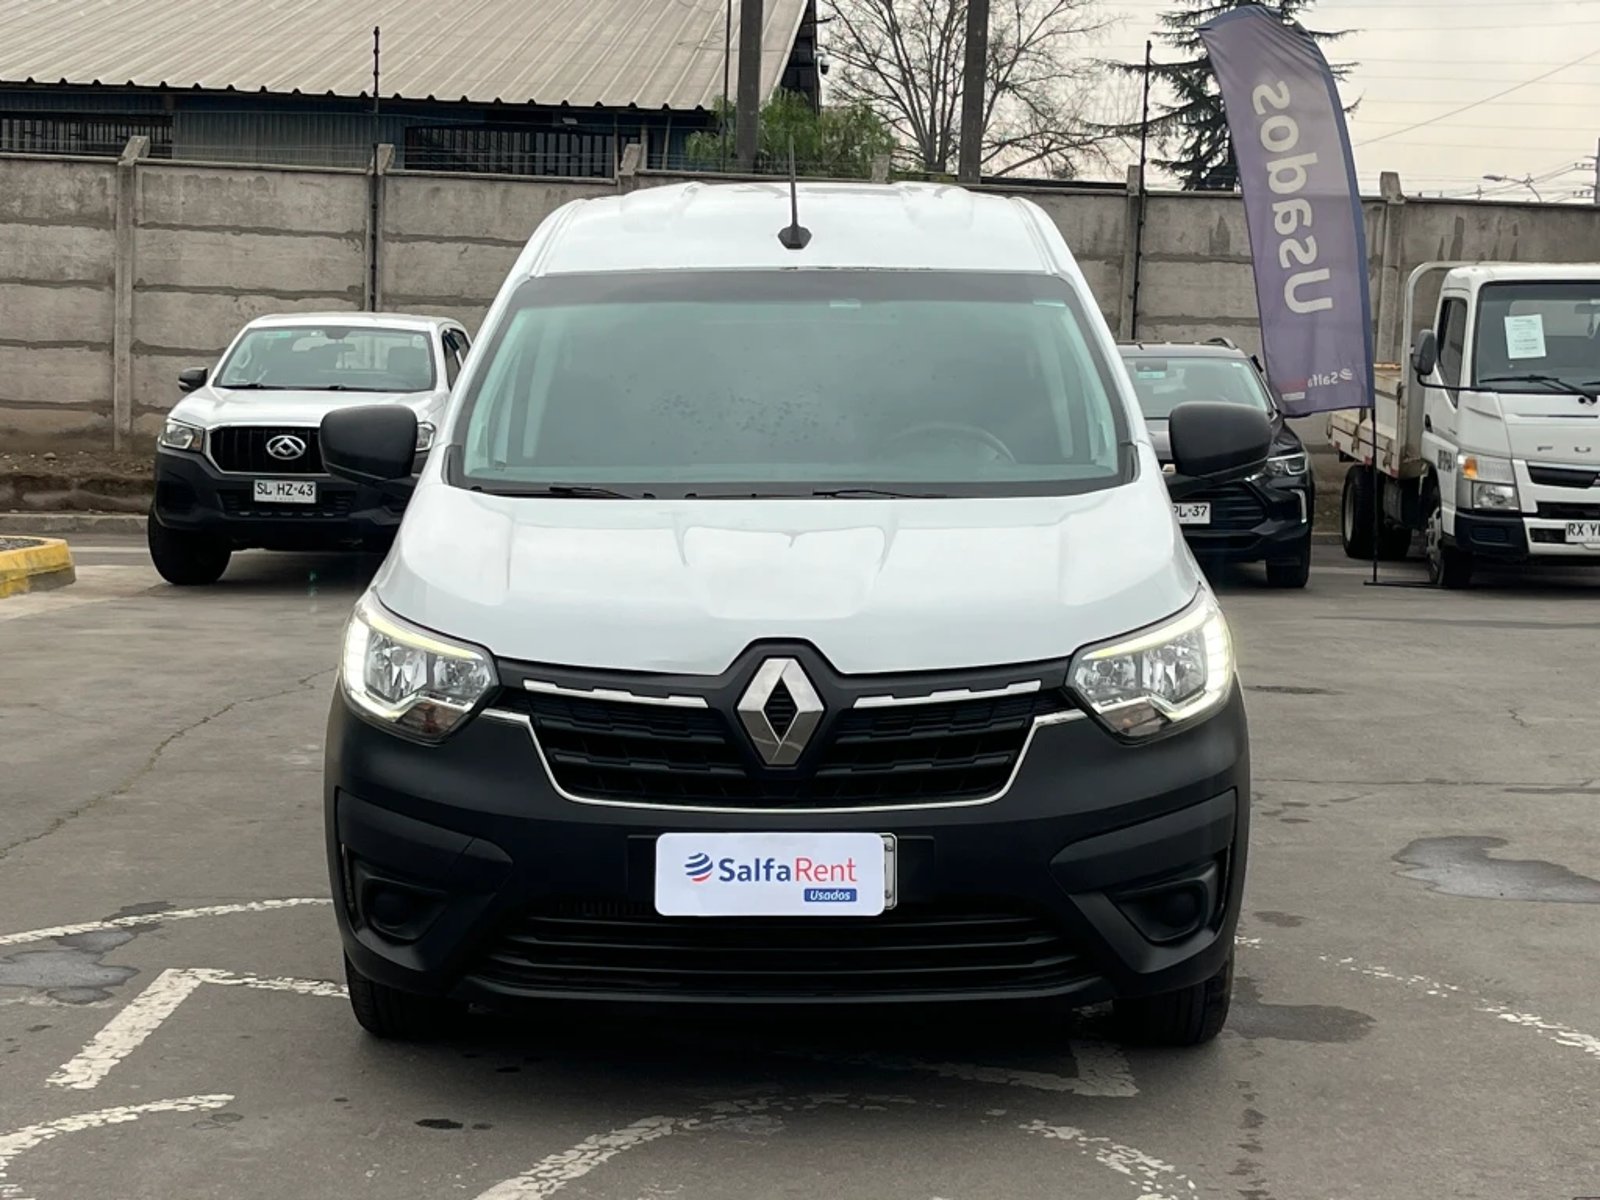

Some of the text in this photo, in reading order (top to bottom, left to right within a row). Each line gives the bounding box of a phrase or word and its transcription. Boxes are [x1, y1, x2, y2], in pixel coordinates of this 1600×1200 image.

[256, 482, 272, 495] SL
[718, 857, 857, 882] SalfaRent
[809, 889, 851, 901] Usados
